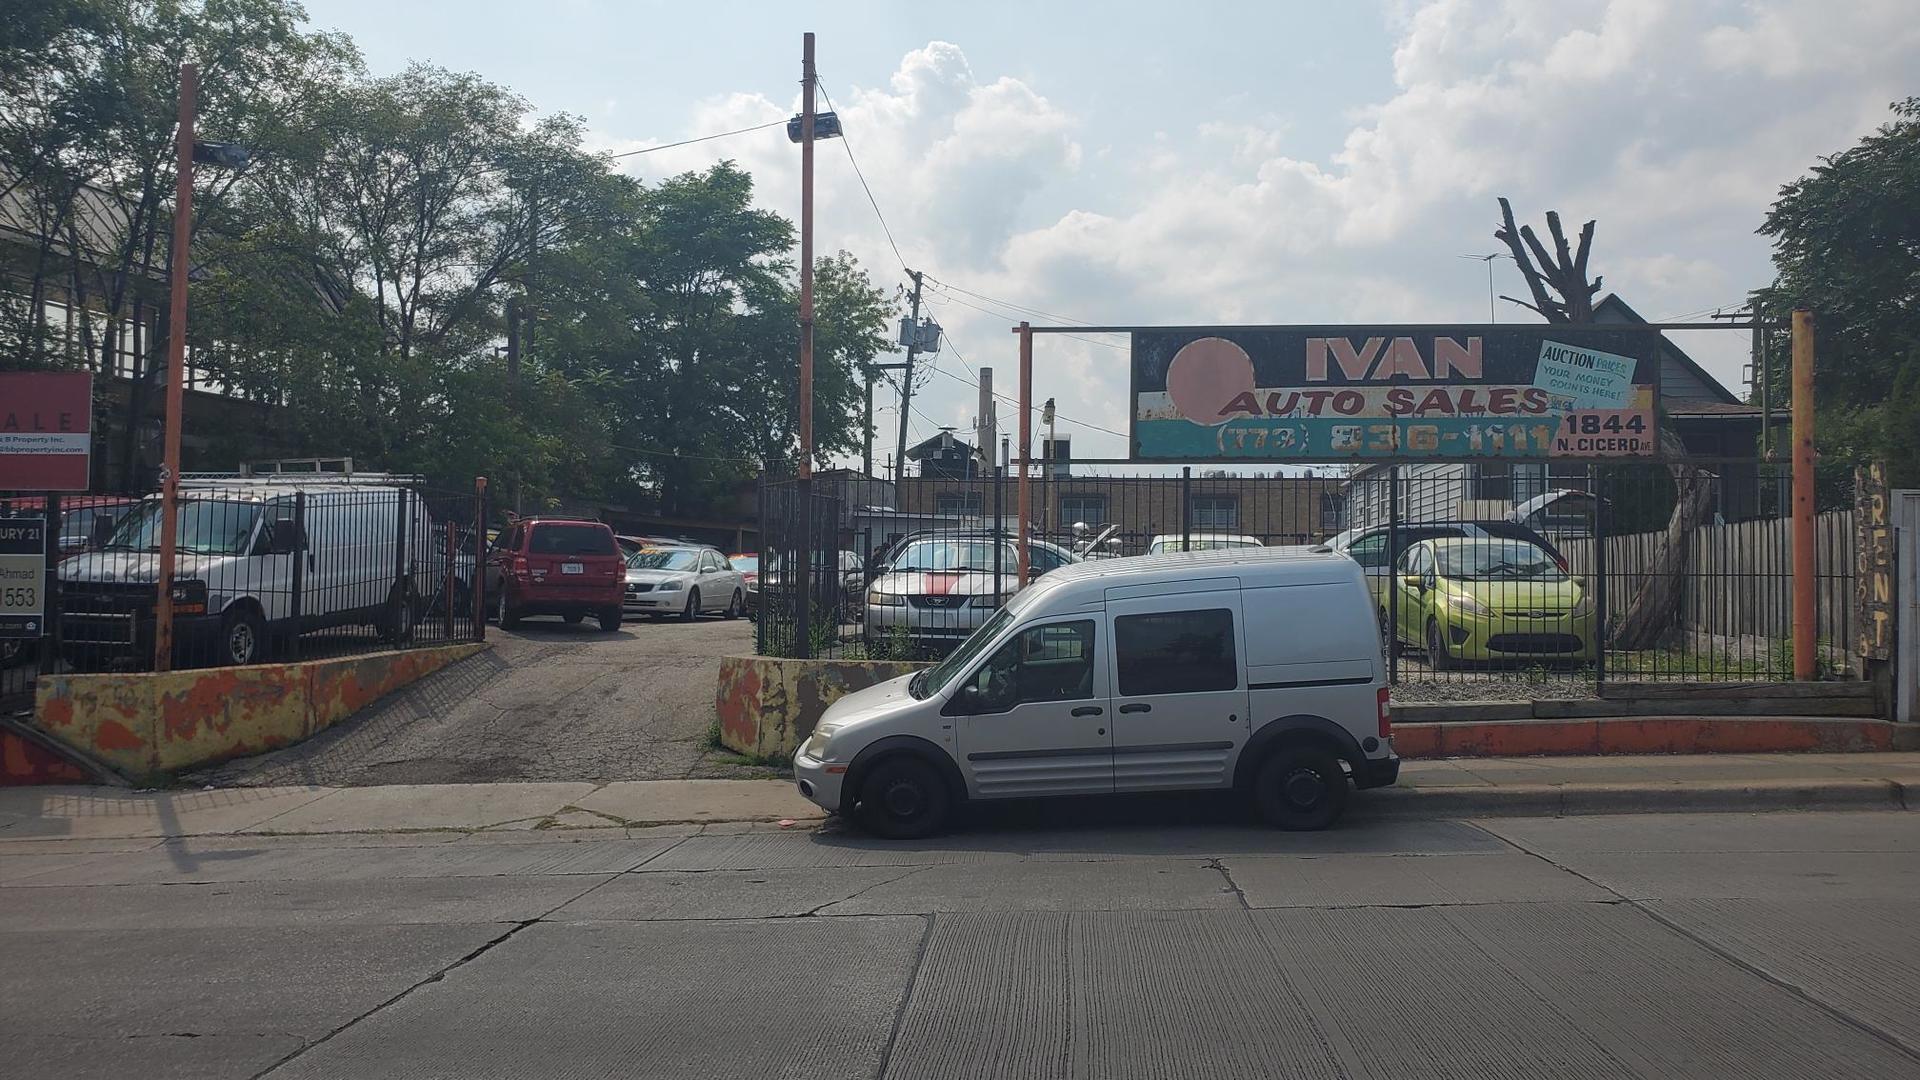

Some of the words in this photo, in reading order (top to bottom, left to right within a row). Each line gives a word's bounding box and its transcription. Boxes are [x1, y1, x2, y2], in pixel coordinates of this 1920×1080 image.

[1305, 336, 1483, 381] IVAN
[1543, 346, 1595, 369] AUCTION
[1595, 358, 1627, 375] PRICES
[1543, 365, 1570, 379] YOUR
[1575, 373, 1614, 386] MONEY
[1549, 378, 1590, 394] COUNTS
[1217, 390, 1366, 416] AUTO
[1382, 388, 1549, 415] SALES
[1566, 414, 1647, 435] 1844
[12, 436, 50, 444] Property
[1216, 424, 1310, 452] (773)
[0, 528, 25, 540] URY
[27, 528, 40, 540] 21
[1871, 494, 1889, 648] RENT
